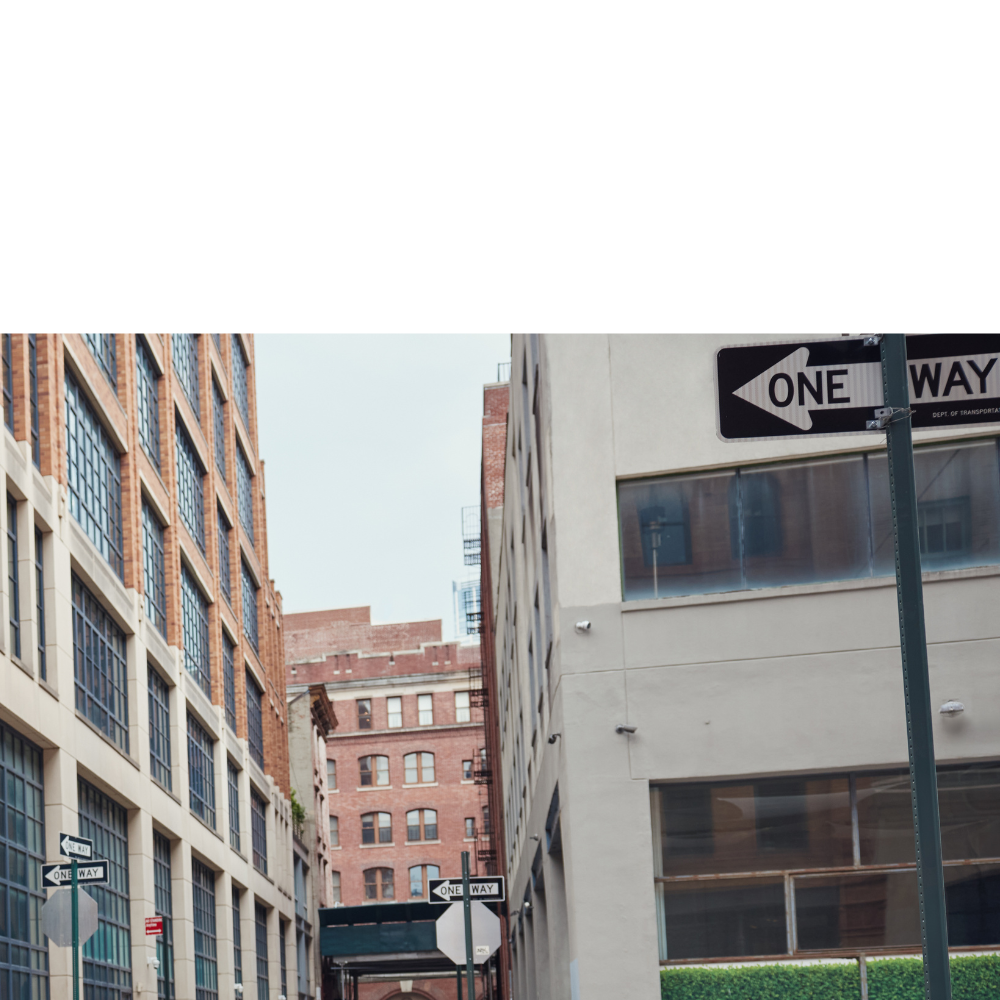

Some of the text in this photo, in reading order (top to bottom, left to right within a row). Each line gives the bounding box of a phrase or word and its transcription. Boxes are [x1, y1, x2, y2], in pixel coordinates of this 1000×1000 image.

[768, 357, 998, 408] ONE WAY
[65, 841, 88, 855] ONE WAY
[54, 868, 98, 880] ONE WAY
[440, 884, 494, 895] ONE WAY
